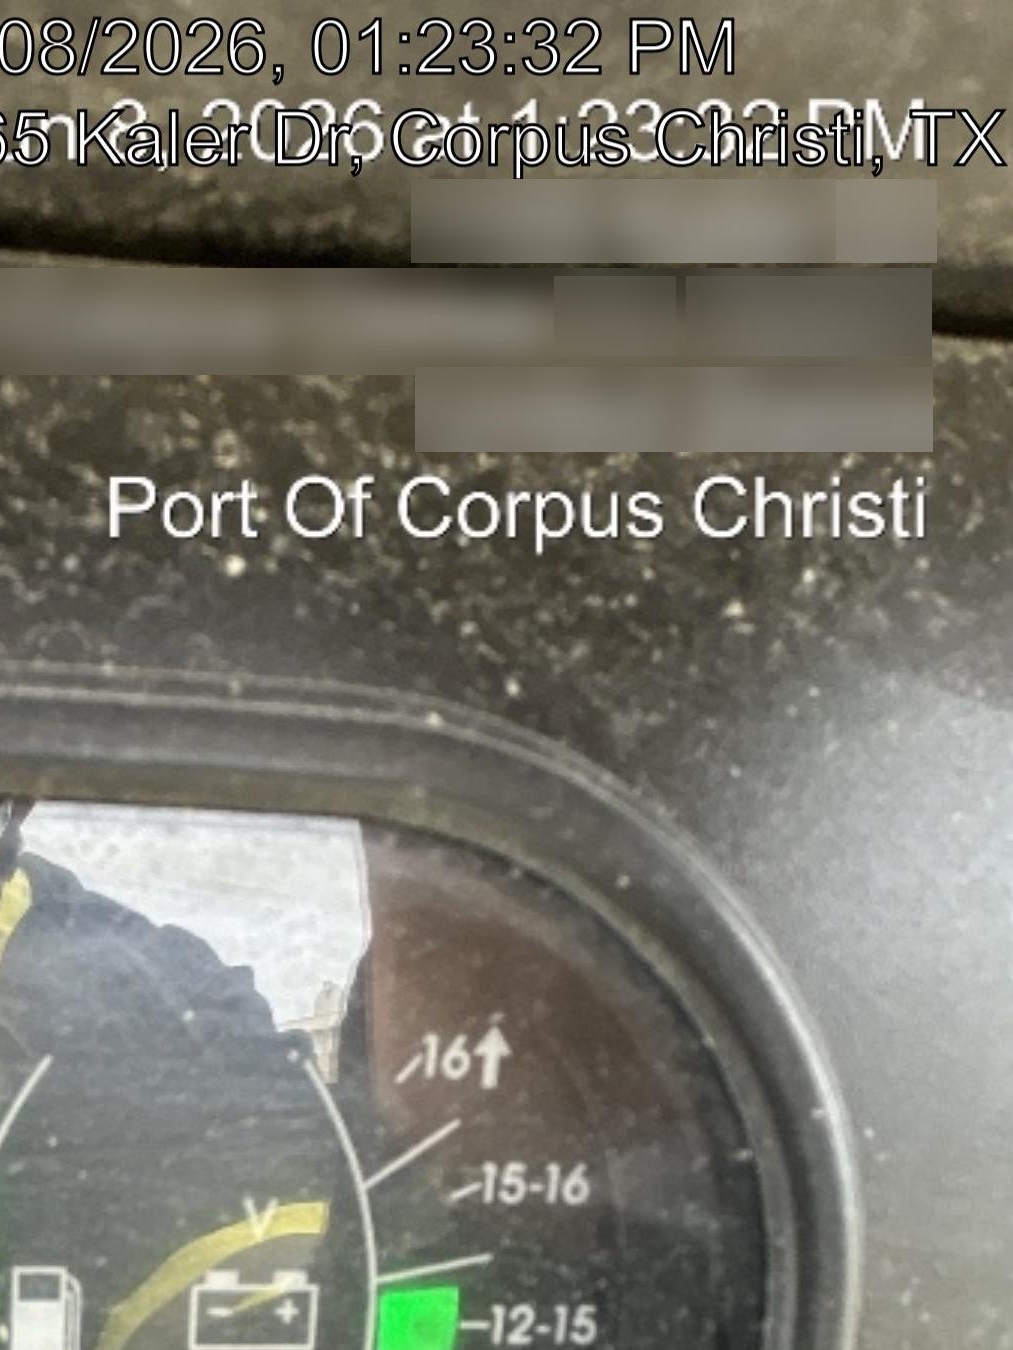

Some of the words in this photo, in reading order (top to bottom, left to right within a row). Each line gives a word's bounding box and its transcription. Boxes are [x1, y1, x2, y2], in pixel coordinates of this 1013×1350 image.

[423, 1034, 470, 1079] 16
[480, 1162, 590, 1202] 15-16
[489, 1304, 597, 1346] 12-15
